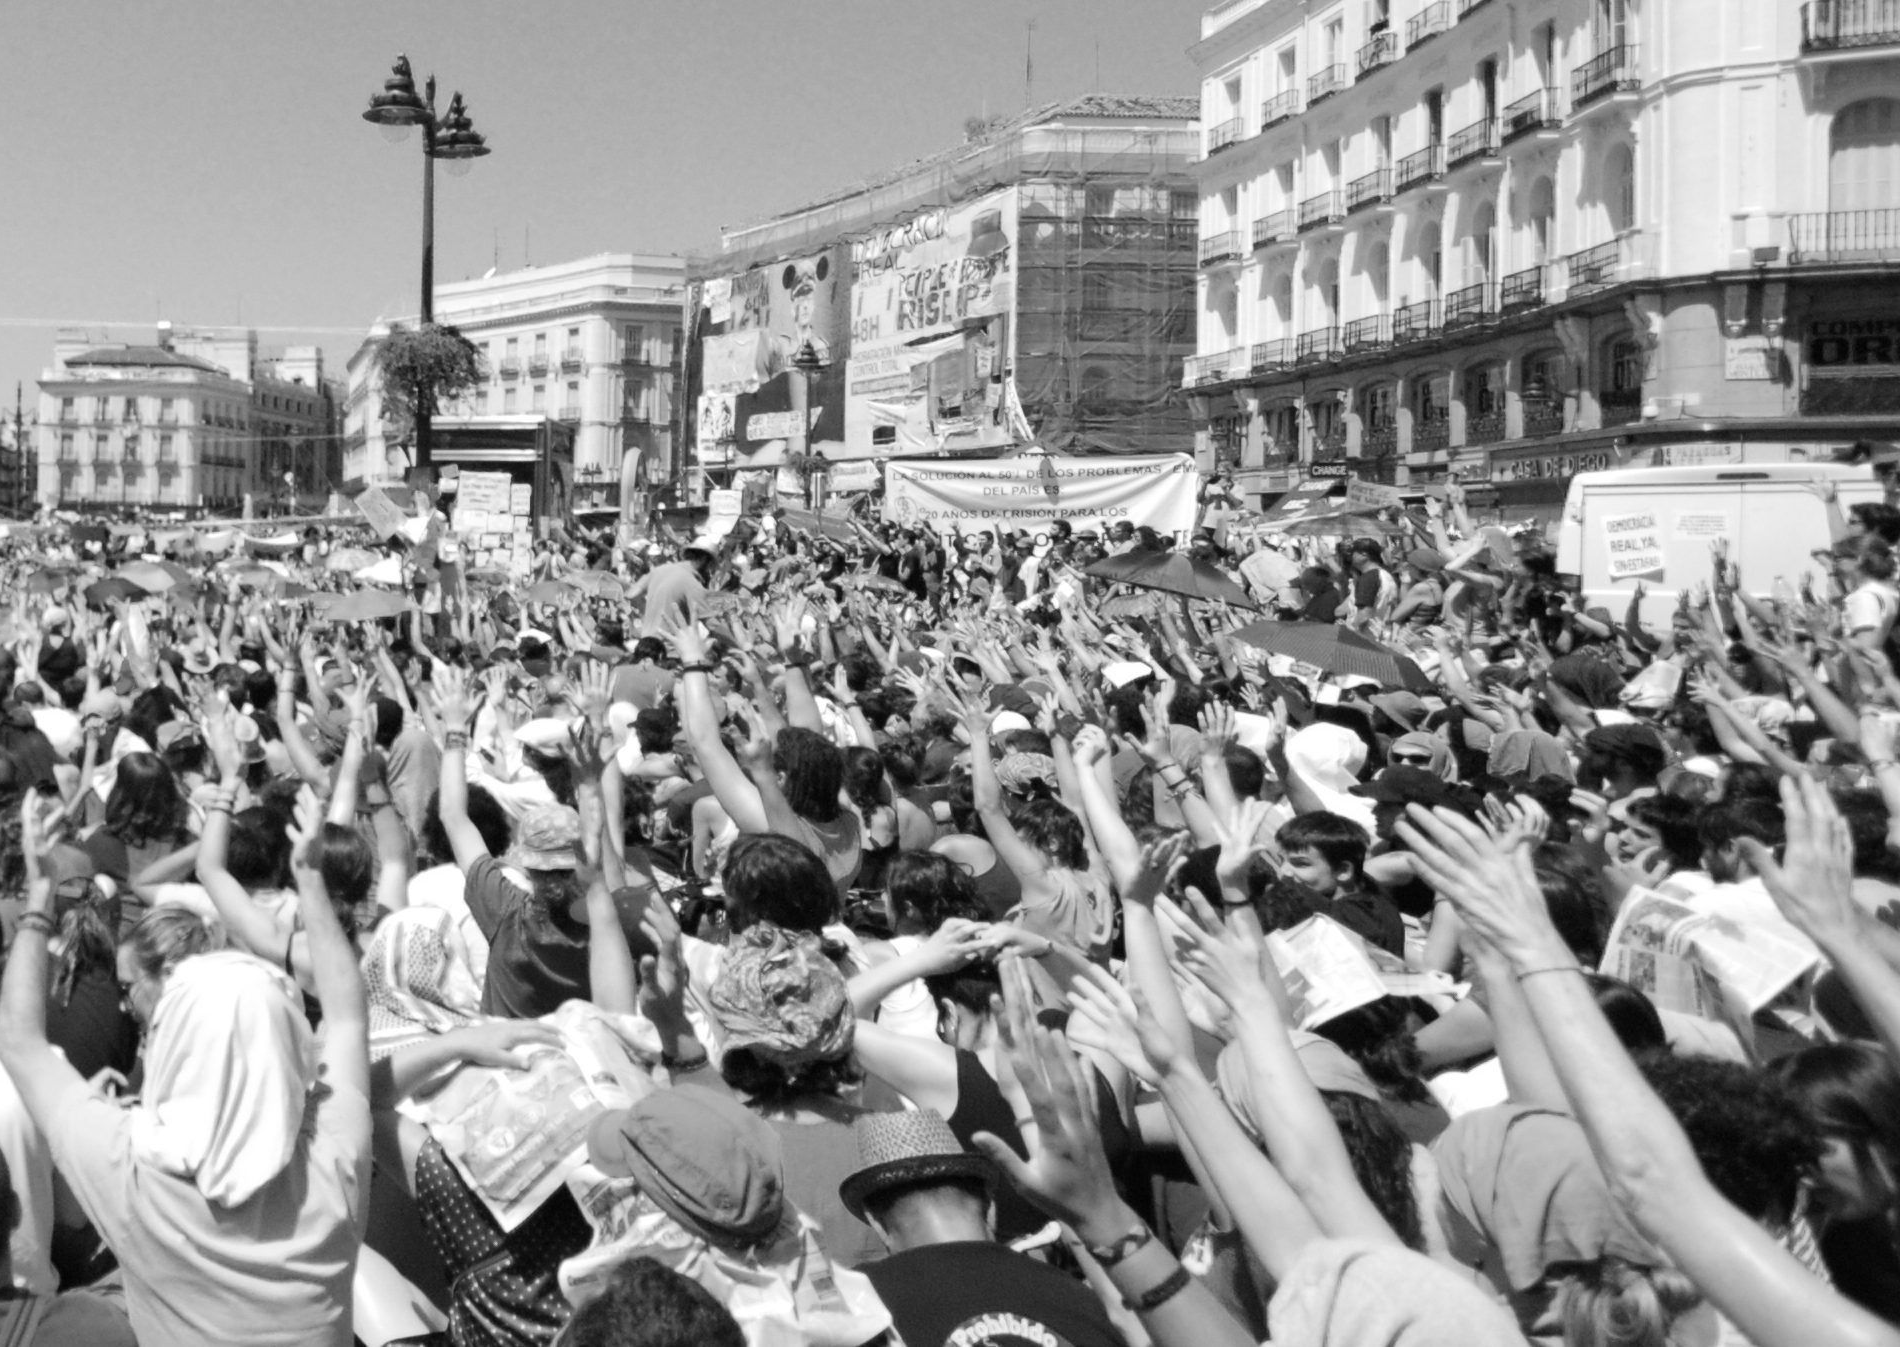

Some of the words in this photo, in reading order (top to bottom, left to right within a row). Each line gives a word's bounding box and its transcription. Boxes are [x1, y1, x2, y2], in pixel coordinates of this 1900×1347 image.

[1811, 336, 1900, 366] OR
[979, 471, 995, 480] AL
[1026, 468, 1043, 480] DE
[1047, 467, 1074, 479] LOS
[1077, 463, 1162, 478] PROBLEMAS
[1311, 465, 1347, 476] CHANGE
[1511, 459, 1541, 478] CASA
[1544, 457, 1560, 478] DE
[1567, 453, 1608, 475] DIEGO
[983, 486, 1008, 496] DEL
[1011, 484, 1039, 496] PAÍS
[1060, 507, 1096, 519] PARA
[1099, 506, 1128, 518] LOS
[950, 1312, 1058, 1347] Prohibido
